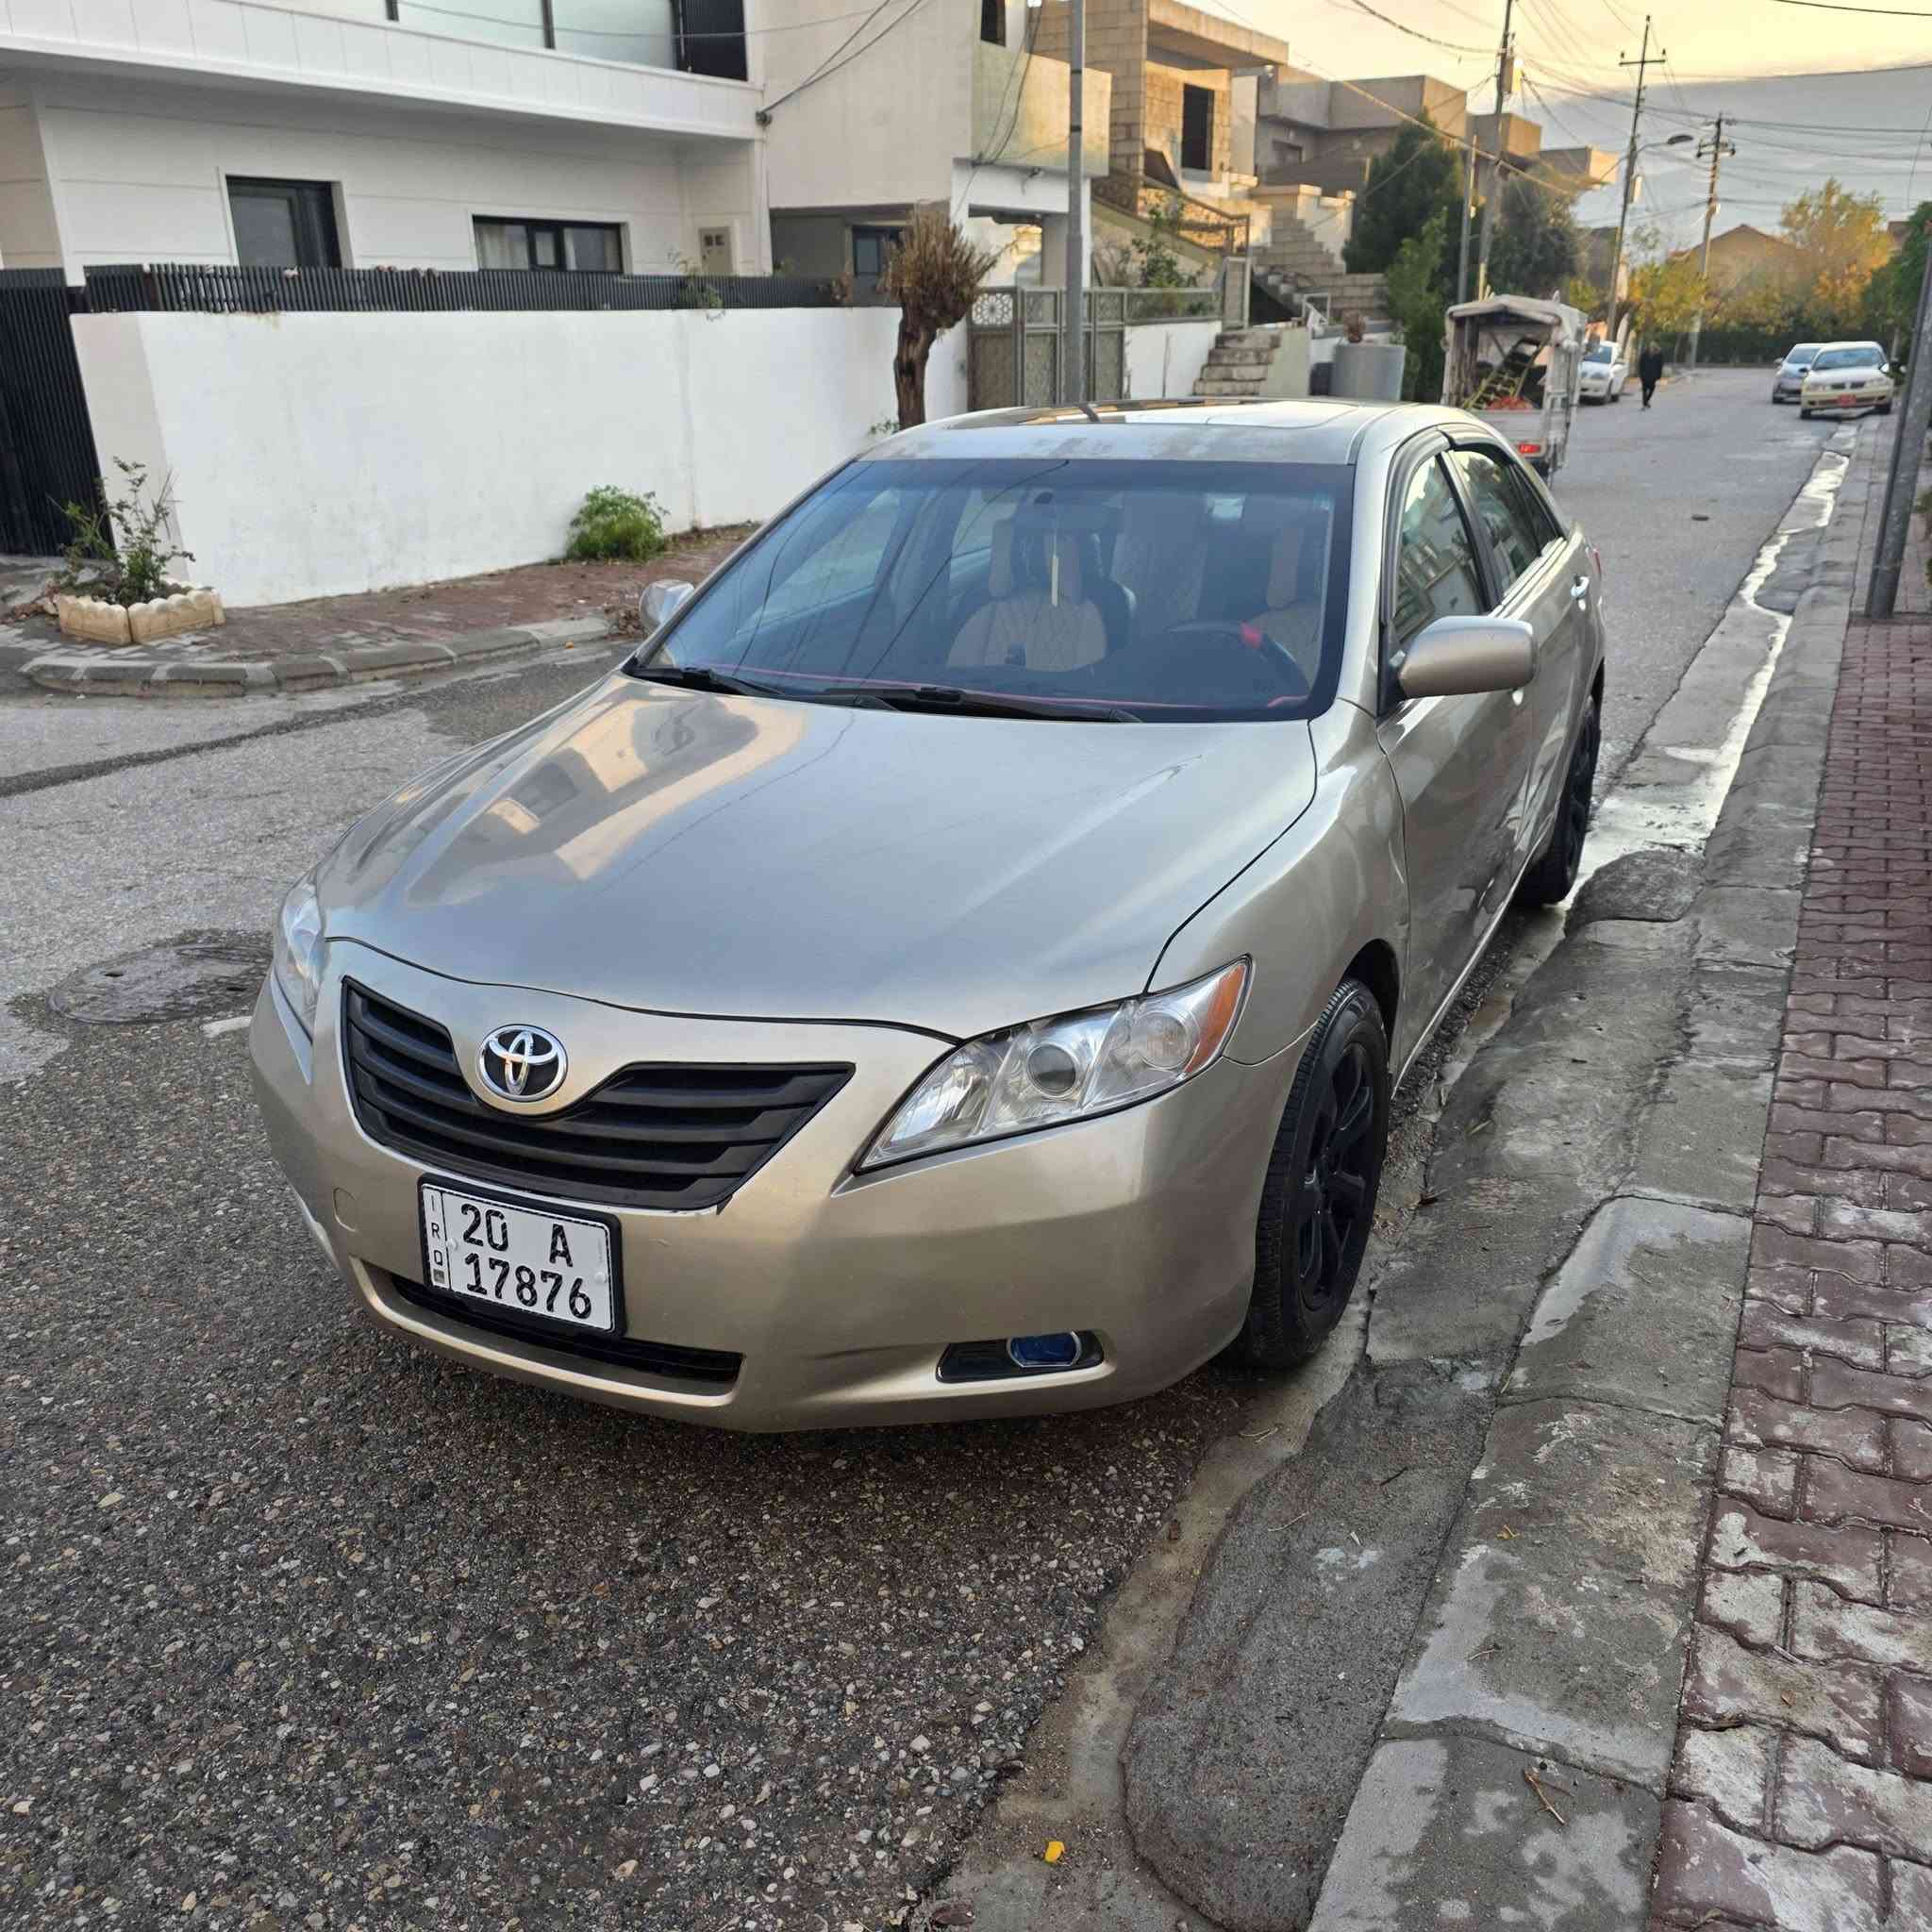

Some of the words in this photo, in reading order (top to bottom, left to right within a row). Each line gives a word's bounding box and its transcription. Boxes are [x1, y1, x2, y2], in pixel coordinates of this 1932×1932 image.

[460, 1203, 508, 1252] 20
[549, 1224, 574, 1268] A
[464, 1252, 591, 1320] 17876
